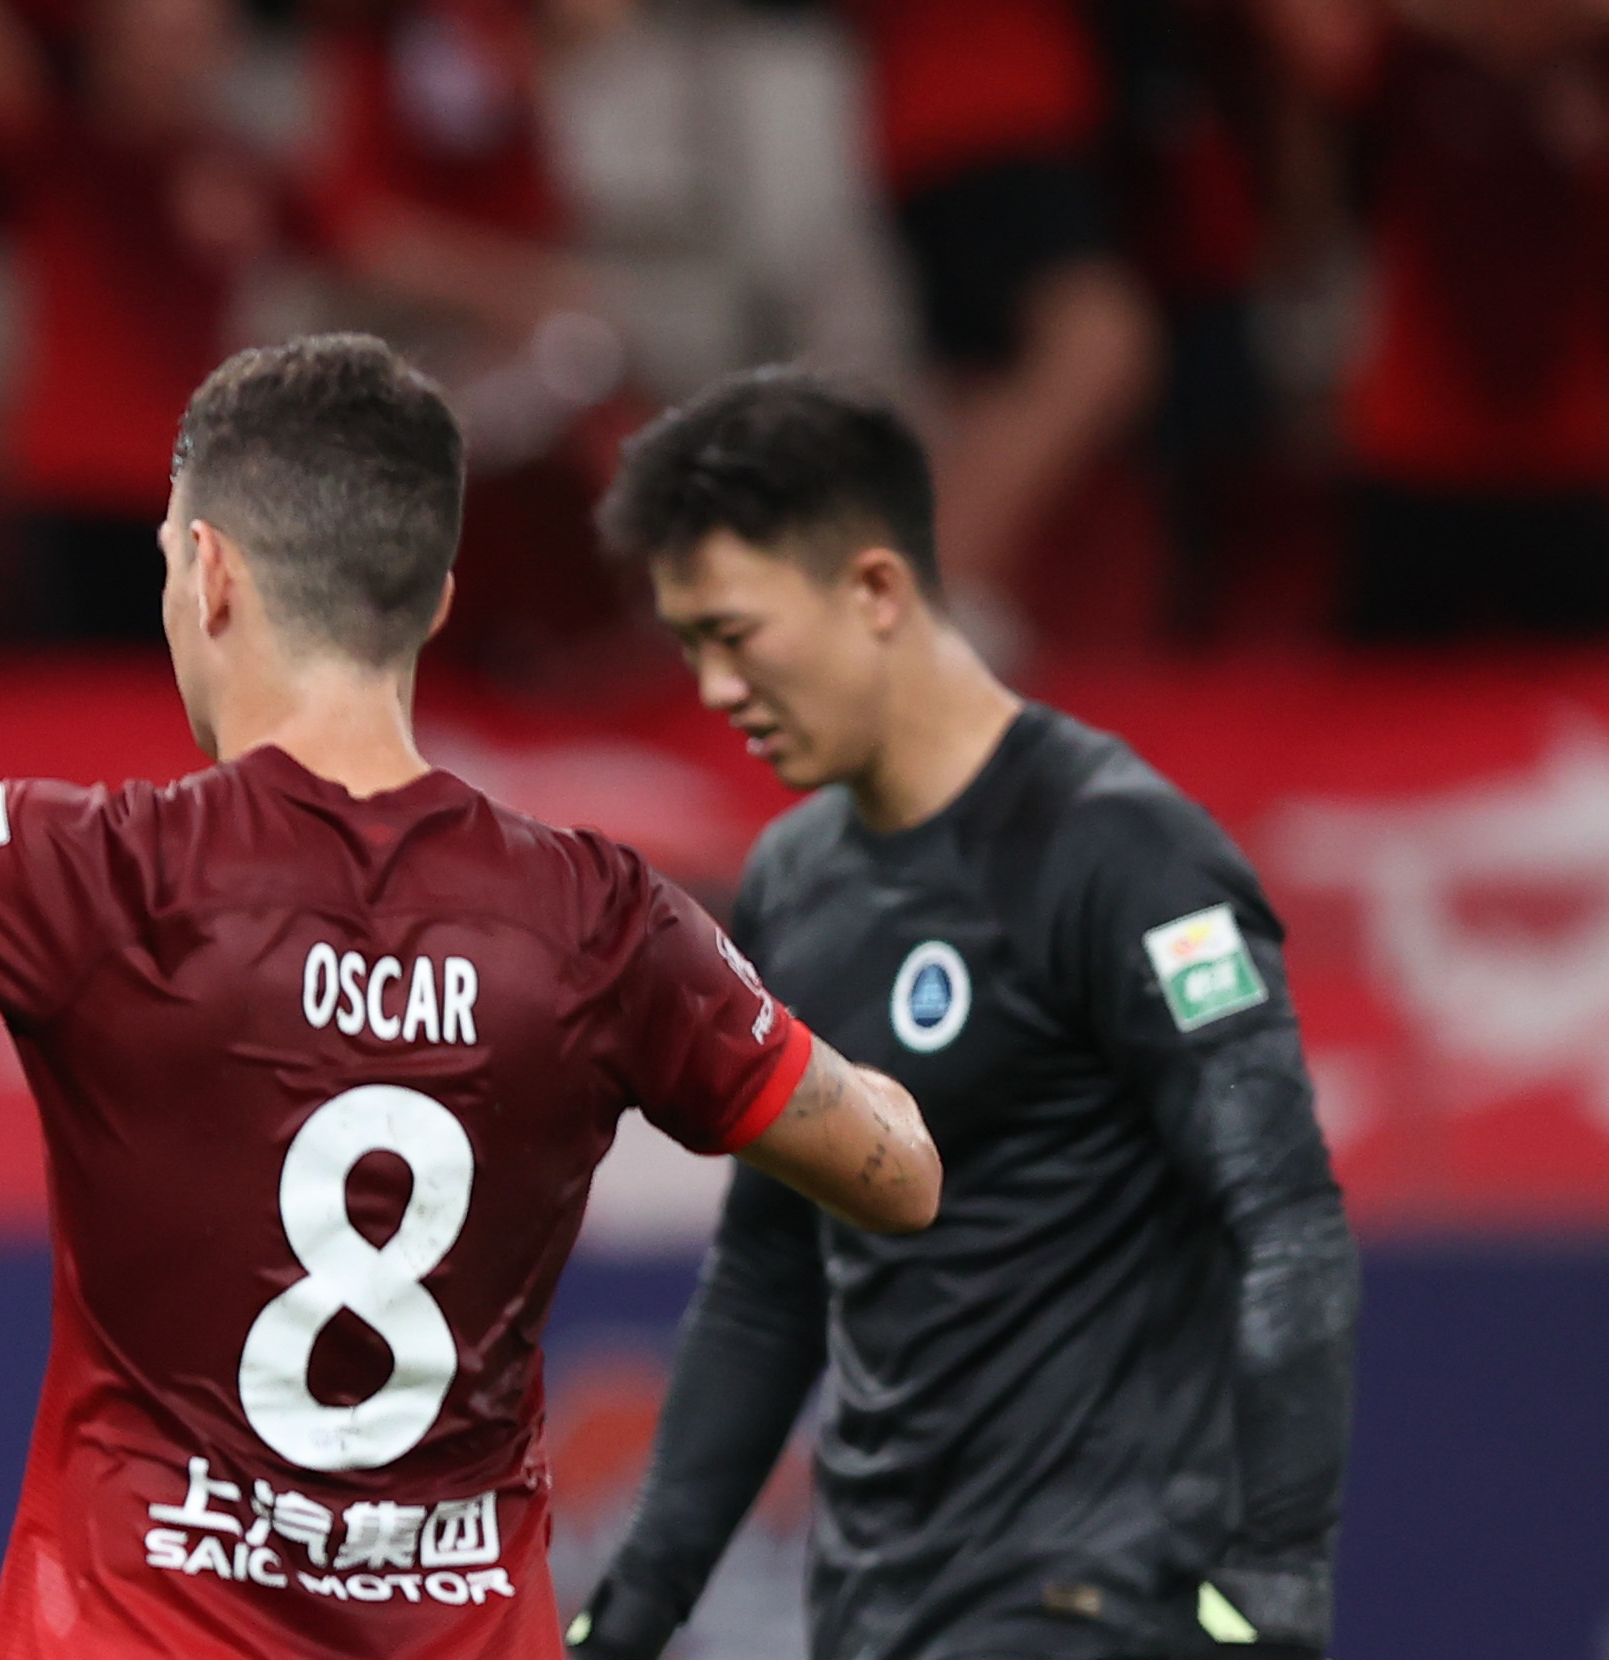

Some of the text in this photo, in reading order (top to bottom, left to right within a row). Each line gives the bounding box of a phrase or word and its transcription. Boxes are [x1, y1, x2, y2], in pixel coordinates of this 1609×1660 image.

[302, 941, 479, 1046] OSCAR
[238, 1084, 474, 1471] 8
[144, 1527, 516, 1605] SAIC MOTOR
[148, 1456, 502, 1569] 上汽集团
